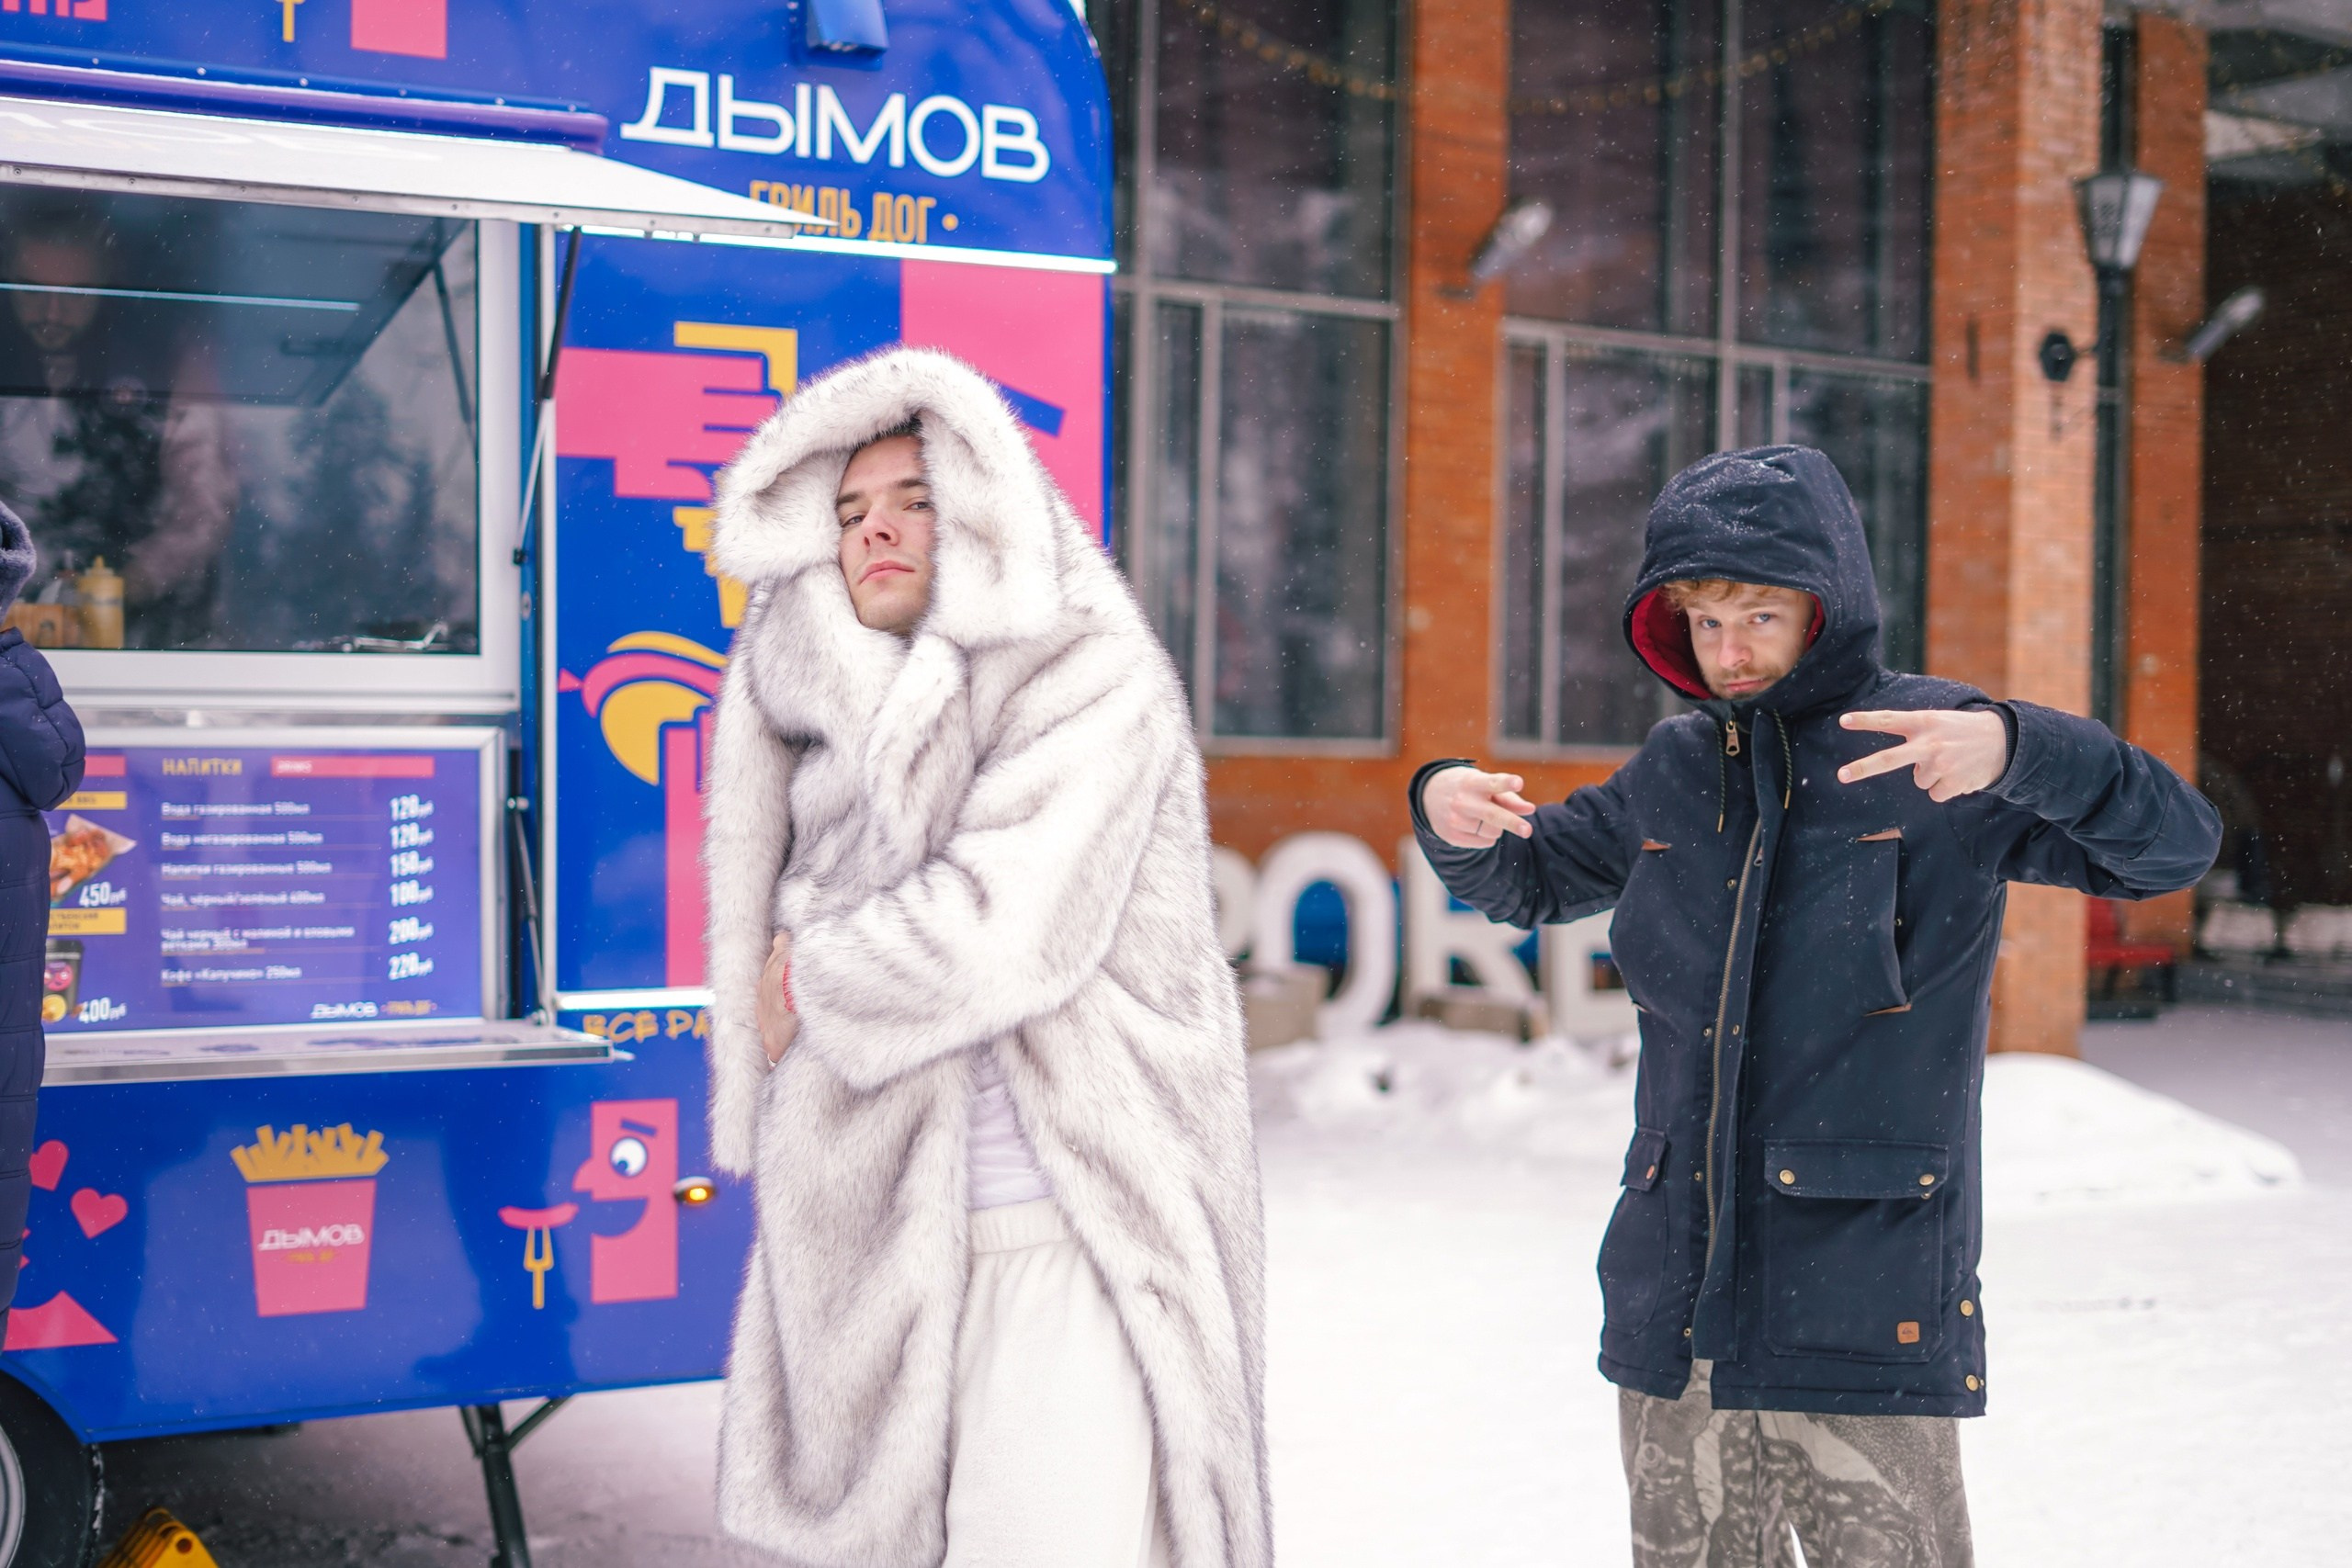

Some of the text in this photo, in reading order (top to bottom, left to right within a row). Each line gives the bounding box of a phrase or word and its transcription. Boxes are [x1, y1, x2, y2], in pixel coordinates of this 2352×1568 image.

[619, 66, 1051, 184] ДЫМОВ
[867, 192, 937, 244] ДОГ
[162, 758, 243, 776] НАПИТКИ
[582, 1010, 659, 1043] ВСЕ
[257, 1223, 366, 1251] ДЫМОВ
